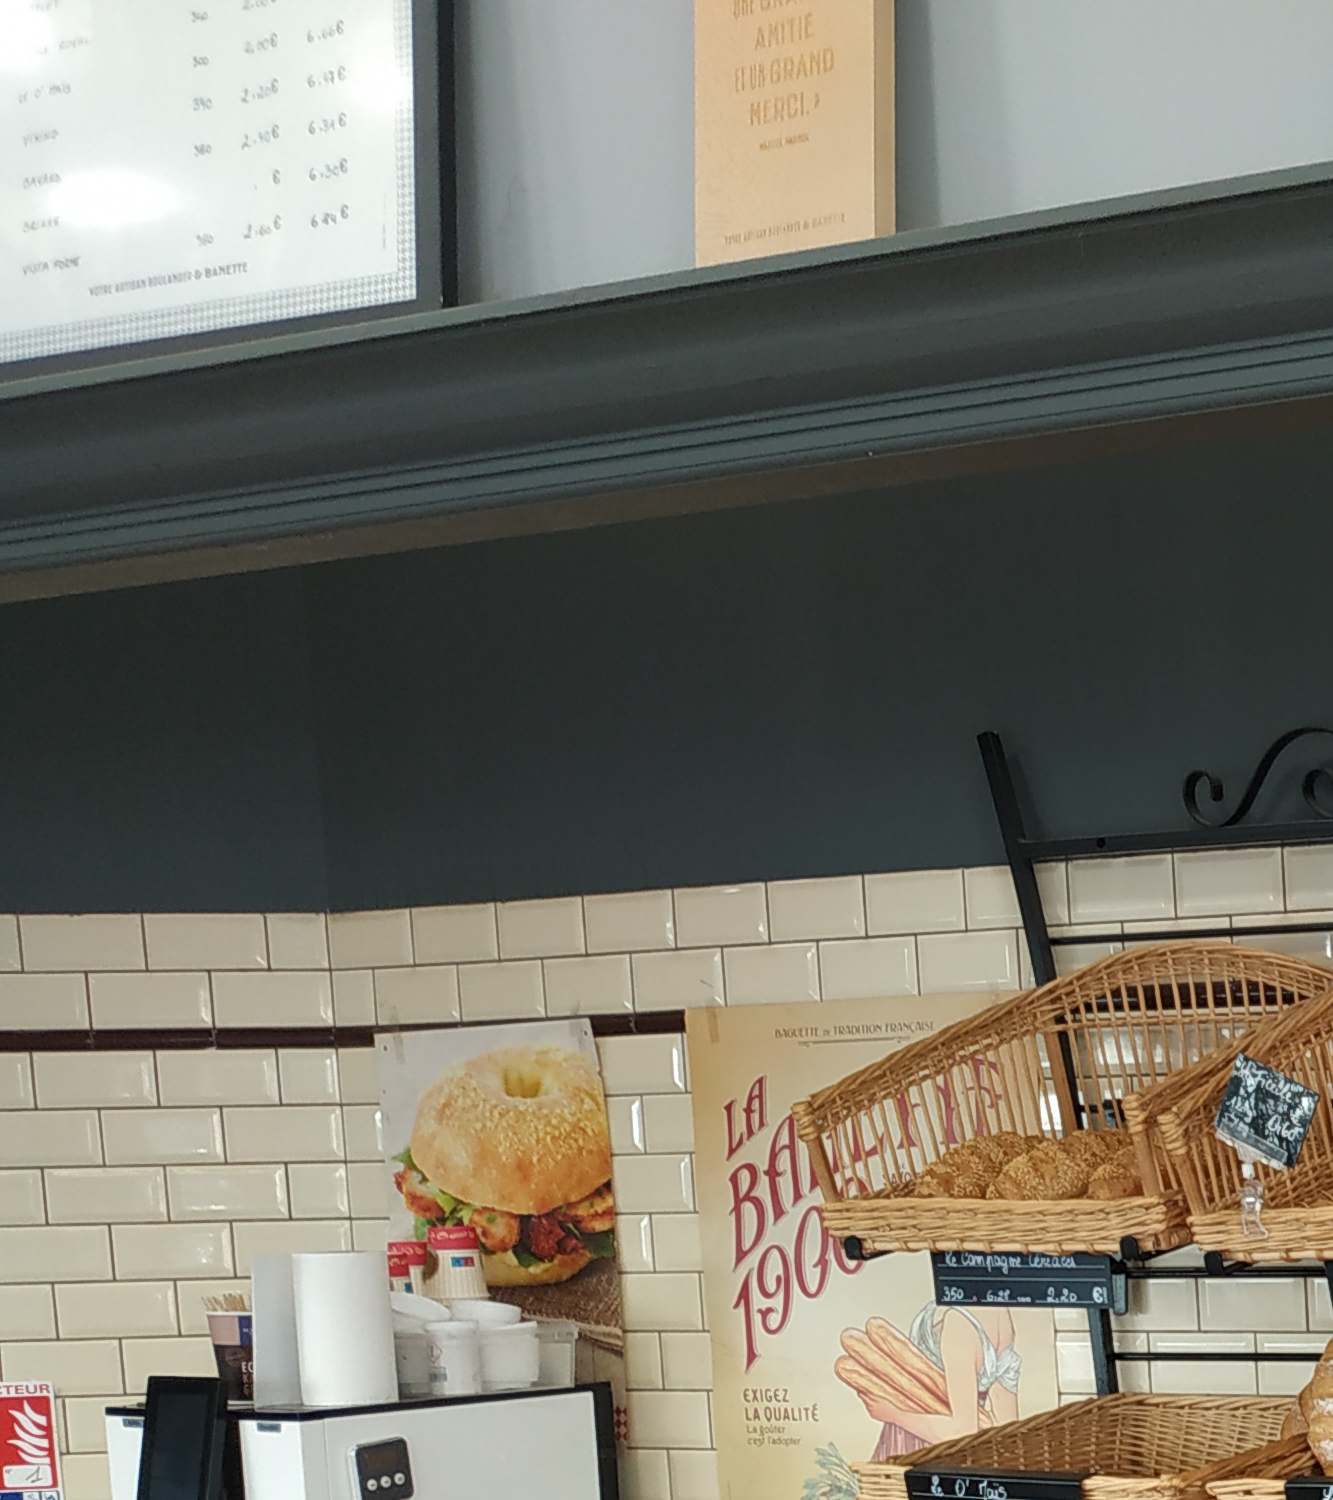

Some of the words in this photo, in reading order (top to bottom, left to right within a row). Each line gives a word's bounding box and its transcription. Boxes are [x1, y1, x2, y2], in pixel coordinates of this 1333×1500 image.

[769, 47, 835, 86] GRAND
[833, 1023, 882, 1036] TRADITION
[723, 1074, 767, 1161] LA
[943, 1286, 964, 1301] 350
[1046, 1287, 1077, 1303] 2,20
[1092, 1287, 1104, 1303] €
[743, 1388, 789, 1403] EXIGEZ
[744, 1407, 761, 1421] LA
[764, 1403, 819, 1422] QUALITÉ
